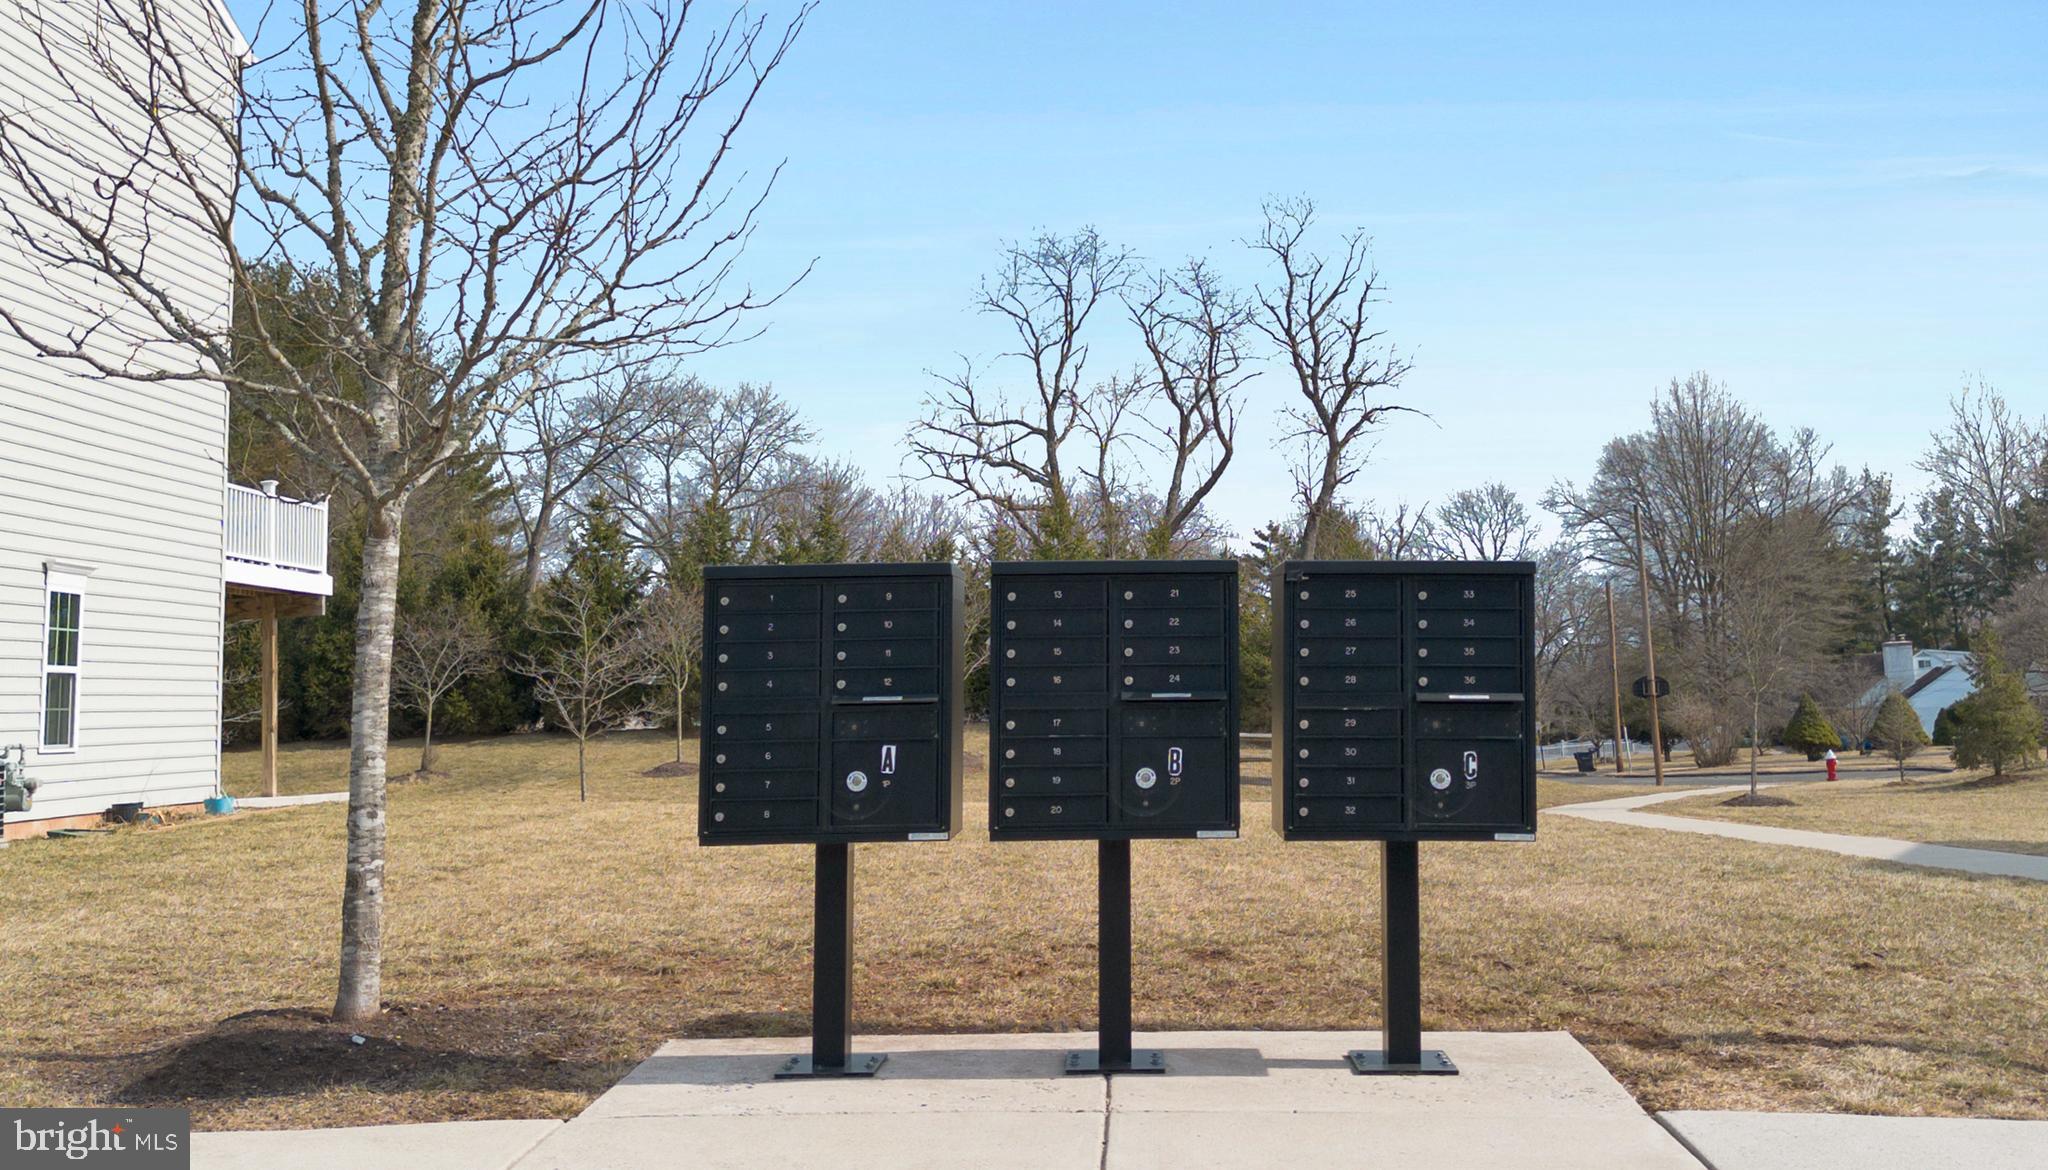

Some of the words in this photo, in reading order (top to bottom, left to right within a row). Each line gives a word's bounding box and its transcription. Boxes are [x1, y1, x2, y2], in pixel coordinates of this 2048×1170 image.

[1053, 590, 1063, 599] 13
[1169, 588, 1180, 598] 21
[1344, 589, 1357, 599] 25
[1463, 589, 1475, 599] 33
[1053, 618, 1063, 627] 14
[1168, 617, 1180, 626] 22
[1345, 618, 1357, 627] 26
[1463, 618, 1476, 628] 34
[1053, 647, 1063, 656] 15
[1168, 645, 1181, 655] 23
[1344, 646, 1357, 656] 27
[1463, 647, 1476, 656] 35
[883, 677, 893, 687] 12
[1052, 675, 1062, 685] 16
[1168, 673, 1181, 683] 24
[1344, 675, 1357, 684] 28
[1463, 675, 1476, 685] 36
[1052, 718, 1062, 728] 17
[1344, 718, 1357, 728] 29
[1344, 747, 1358, 757] 30
[881, 745, 896, 774] A
[1168, 747, 1182, 776] B
[1464, 751, 1477, 780] C
[1051, 775, 1062, 785] 19
[1346, 776, 1356, 785] 31
[1050, 805, 1063, 815] 20
[1344, 805, 1357, 815] 32
